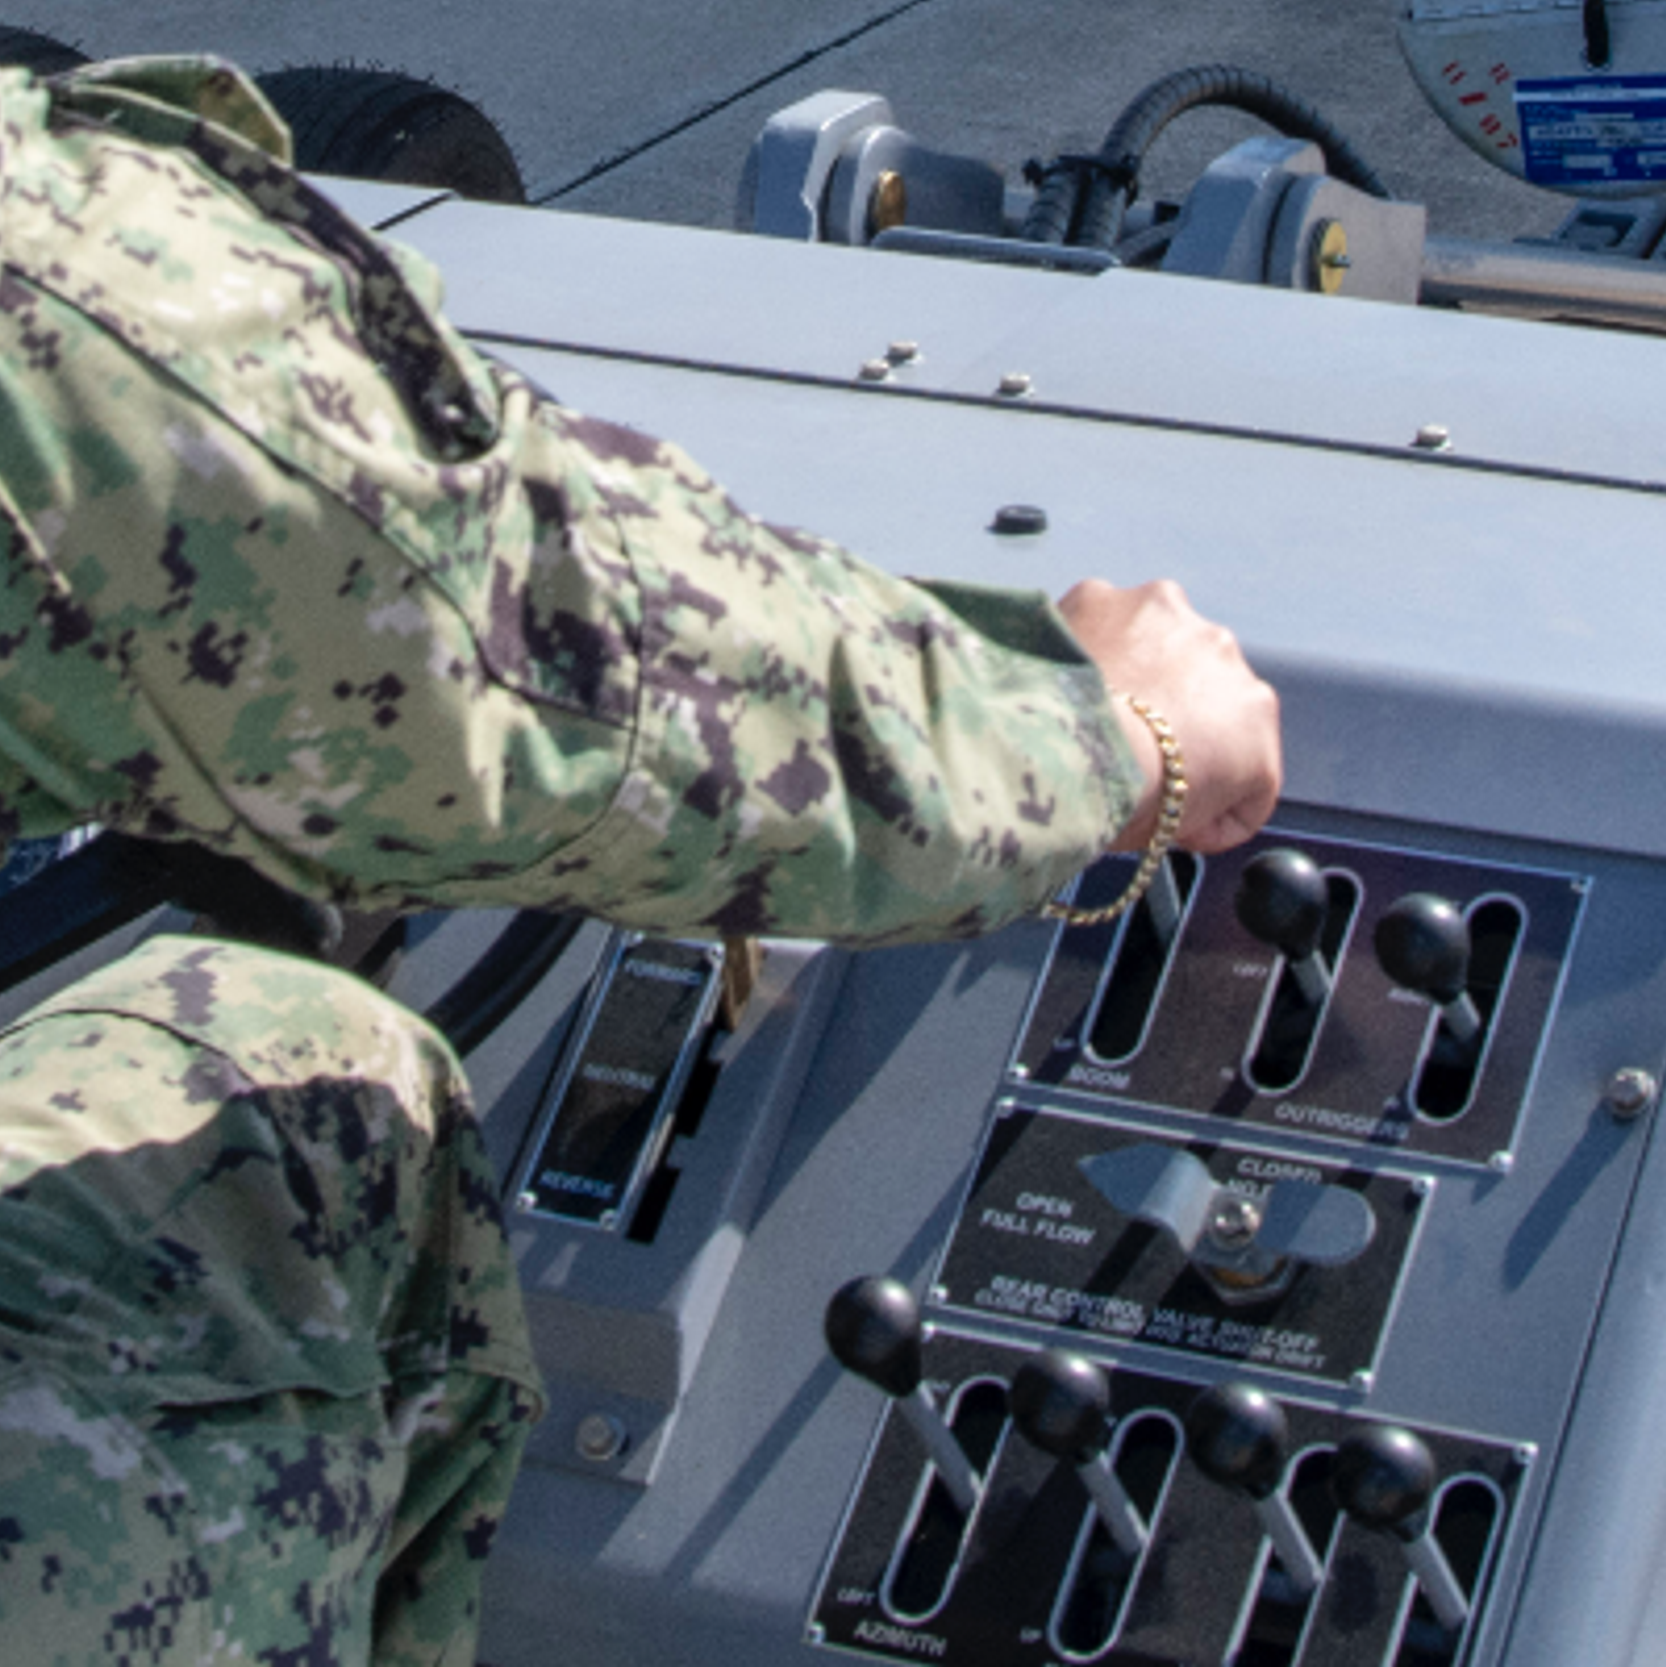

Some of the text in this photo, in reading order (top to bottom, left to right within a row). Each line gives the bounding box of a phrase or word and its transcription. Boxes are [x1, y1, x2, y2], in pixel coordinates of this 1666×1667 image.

[1069, 1063, 1131, 1090] BOOM
[1274, 1101, 1410, 1141] OUTRIGGERS
[1015, 1191, 1073, 1218] OPEN
[979, 1207, 1097, 1245] FULL FLOW
[990, 1273, 1319, 1352] REAR CONTROL VALVE SHUT-OFF
[853, 1619, 947, 1657] AZIMUTH
